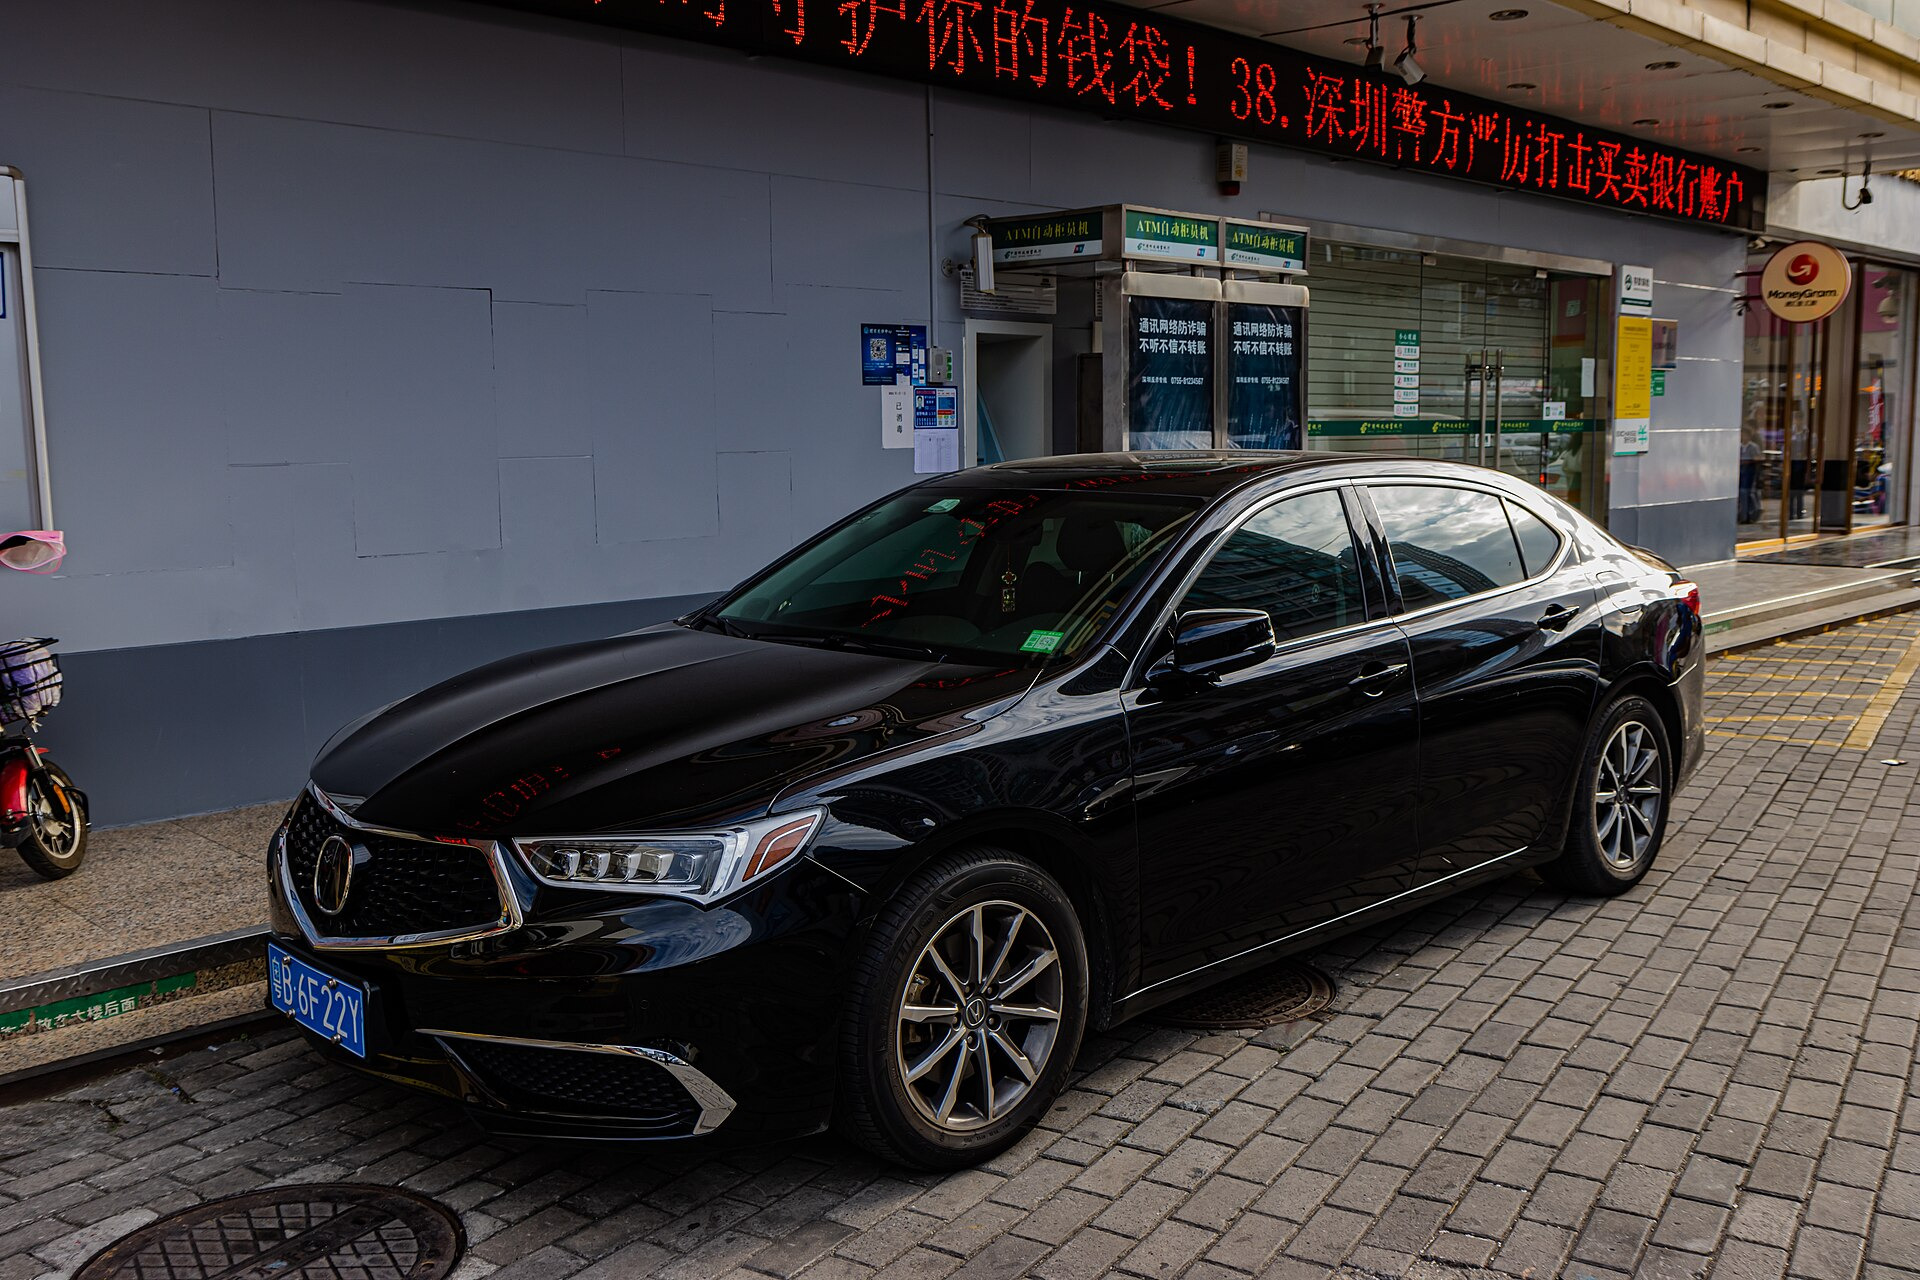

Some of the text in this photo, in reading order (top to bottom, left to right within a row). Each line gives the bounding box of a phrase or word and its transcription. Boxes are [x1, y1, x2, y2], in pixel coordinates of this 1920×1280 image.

[1767, 289, 1838, 301] MoneyGram
[1139, 317, 1207, 337] 通讯网络防诈骗
[1233, 321, 1293, 339] 通讯网络防诈骗
[1139, 338, 1207, 355] 不听不信不转账
[1233, 341, 1293, 356] 不听不信不转账
